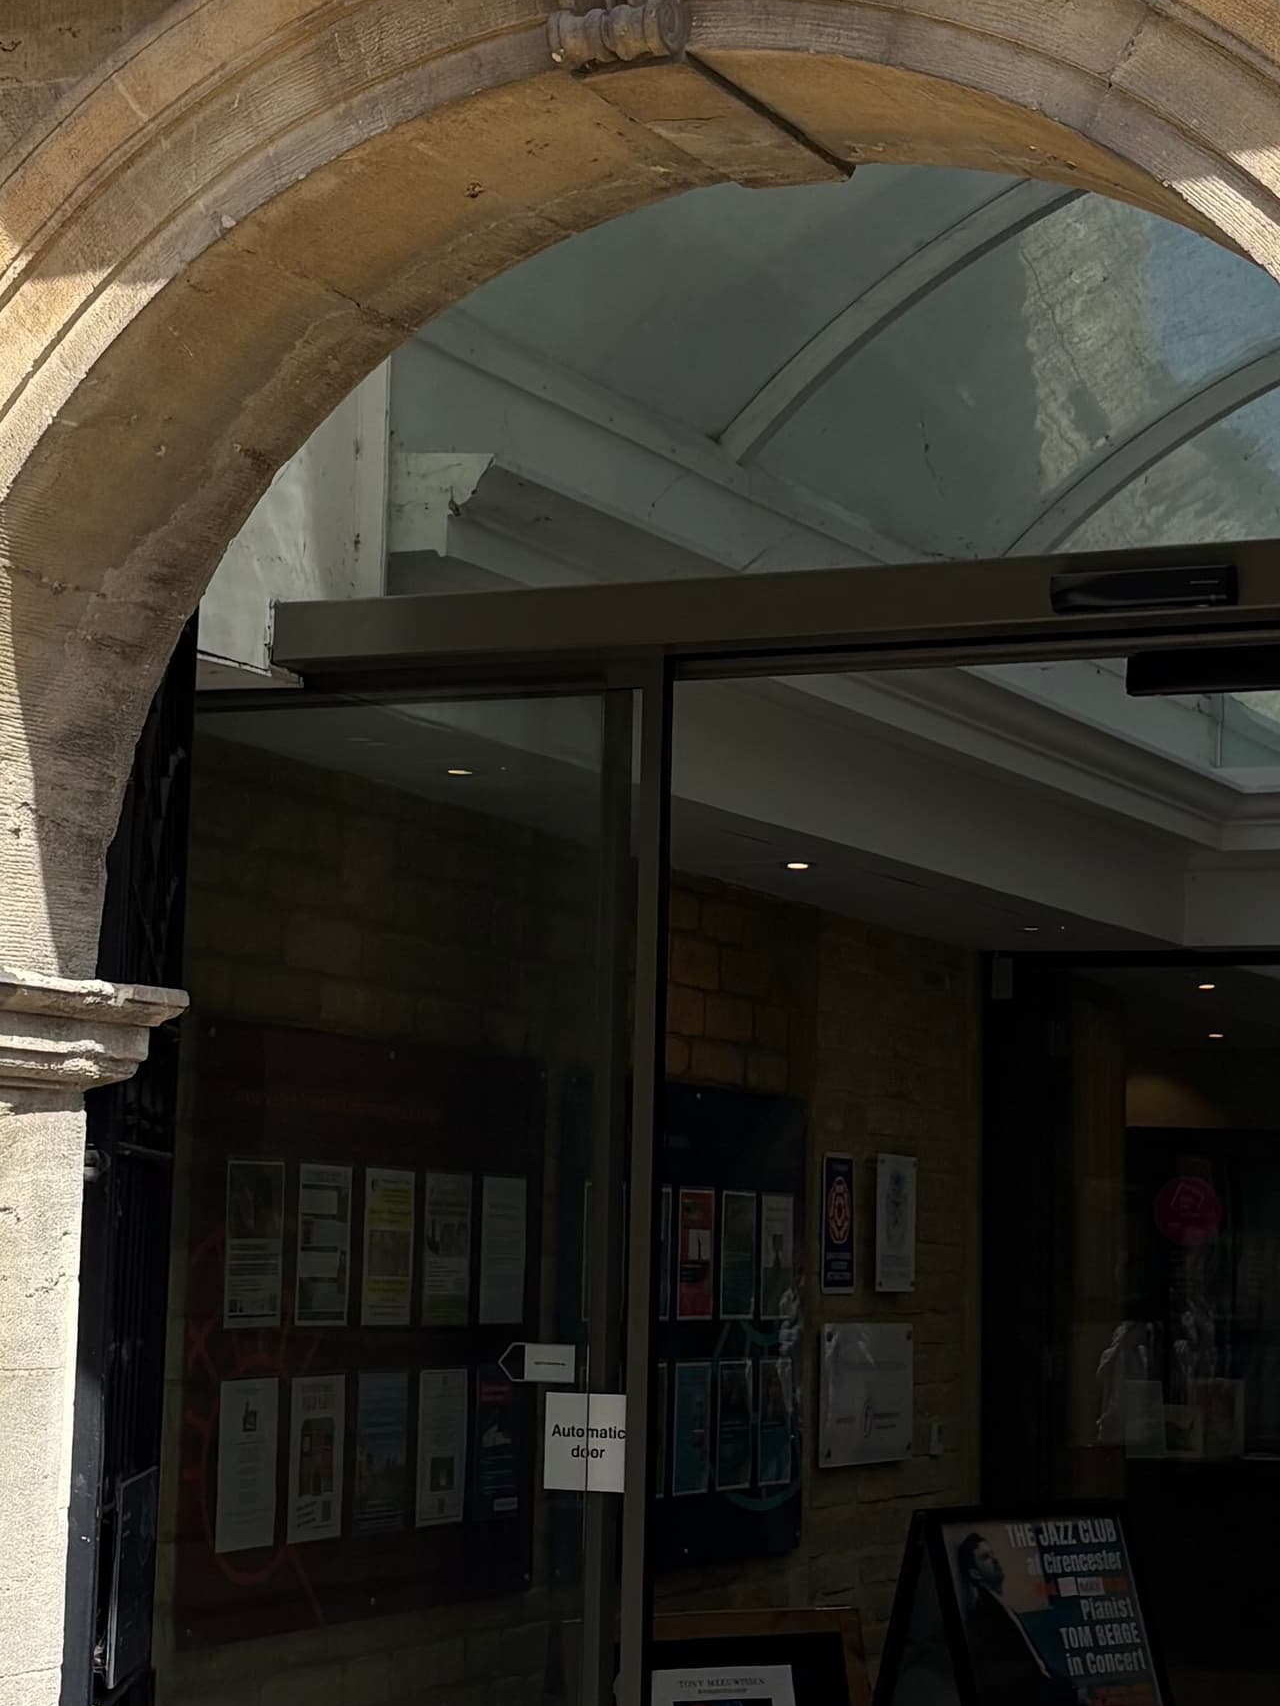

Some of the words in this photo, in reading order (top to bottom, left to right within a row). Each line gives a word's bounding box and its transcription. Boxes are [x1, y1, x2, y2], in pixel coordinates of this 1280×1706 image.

[551, 1424, 627, 1439] Automatic
[571, 1445, 605, 1458] door
[1005, 1523, 1038, 1548] THE
[1038, 1520, 1076, 1546] JAZZ
[1077, 1518, 1117, 1544] CLUB
[1043, 1550, 1122, 1574] Cirencester
[1080, 1596, 1135, 1621] Pianist
[1059, 1625, 1094, 1649] TOM
[1065, 1653, 1084, 1676] in
[1085, 1648, 1147, 1674] Concert
